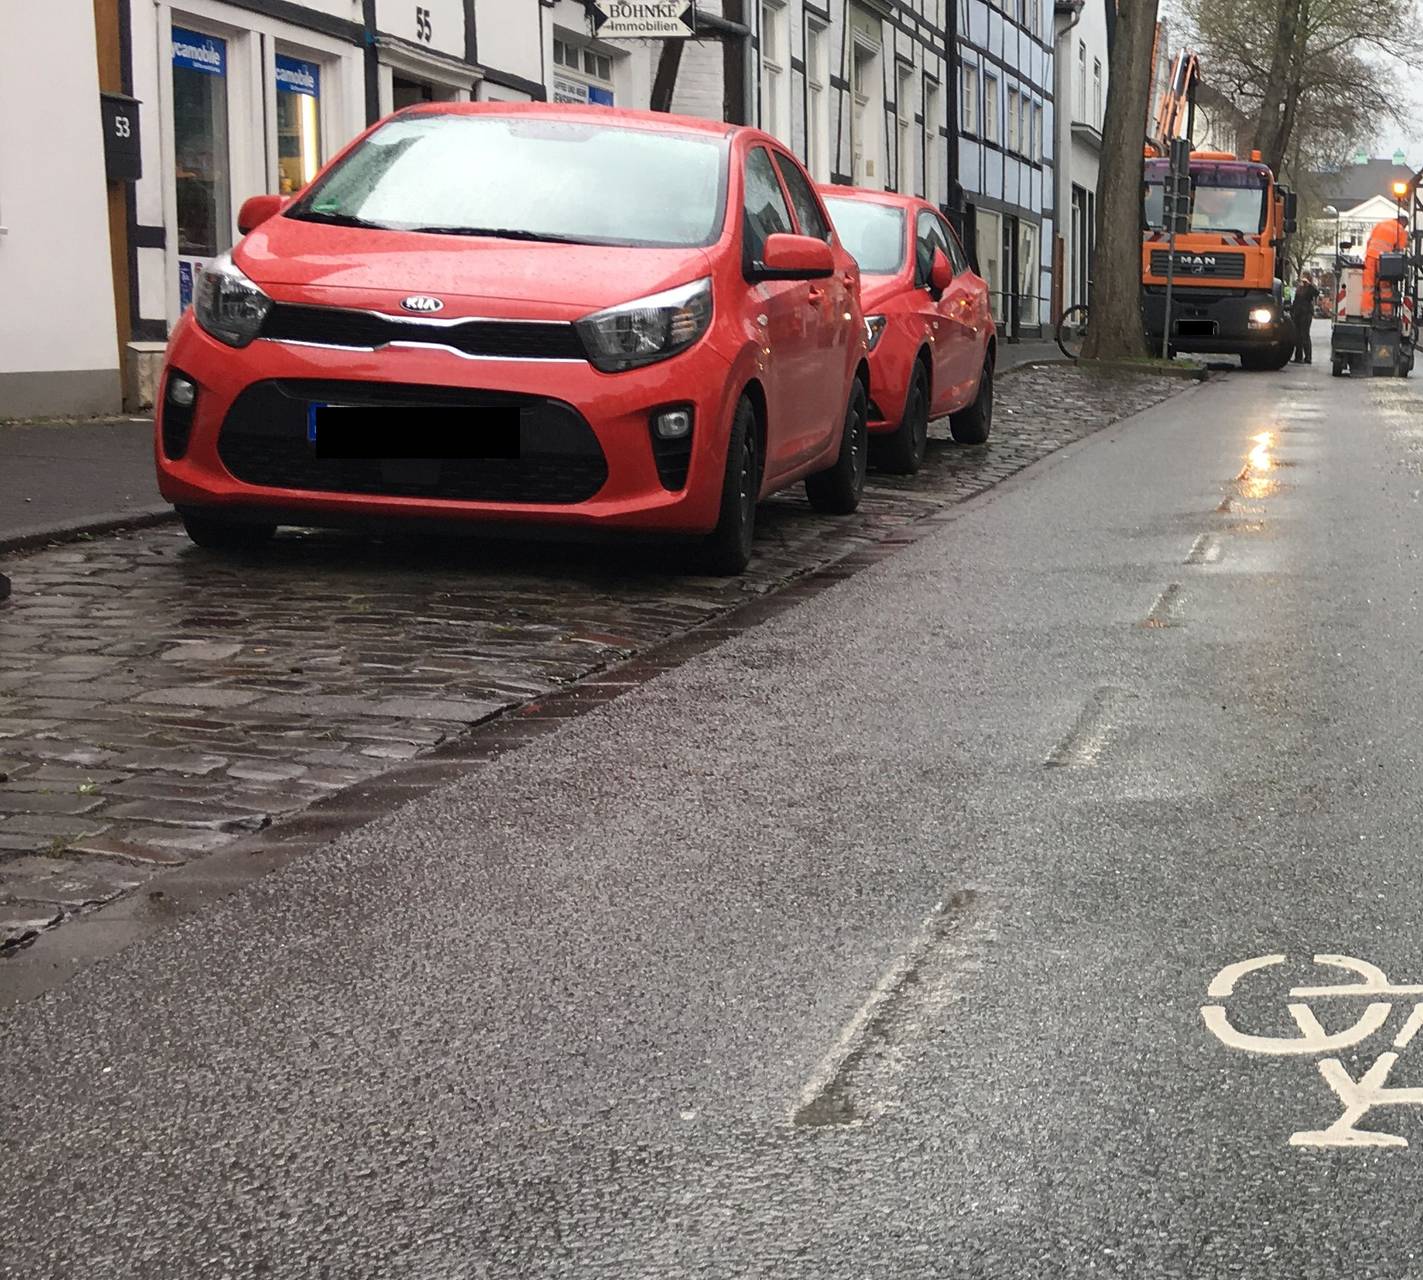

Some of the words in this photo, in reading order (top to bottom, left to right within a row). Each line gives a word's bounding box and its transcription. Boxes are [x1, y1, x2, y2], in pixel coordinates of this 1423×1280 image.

[416, 6, 432, 43] 55
[172, 42, 221, 65] ycamobile
[115, 116, 130, 137] 53
[1180, 256, 1216, 265] MAN
[406, 297, 437, 310] KIA
